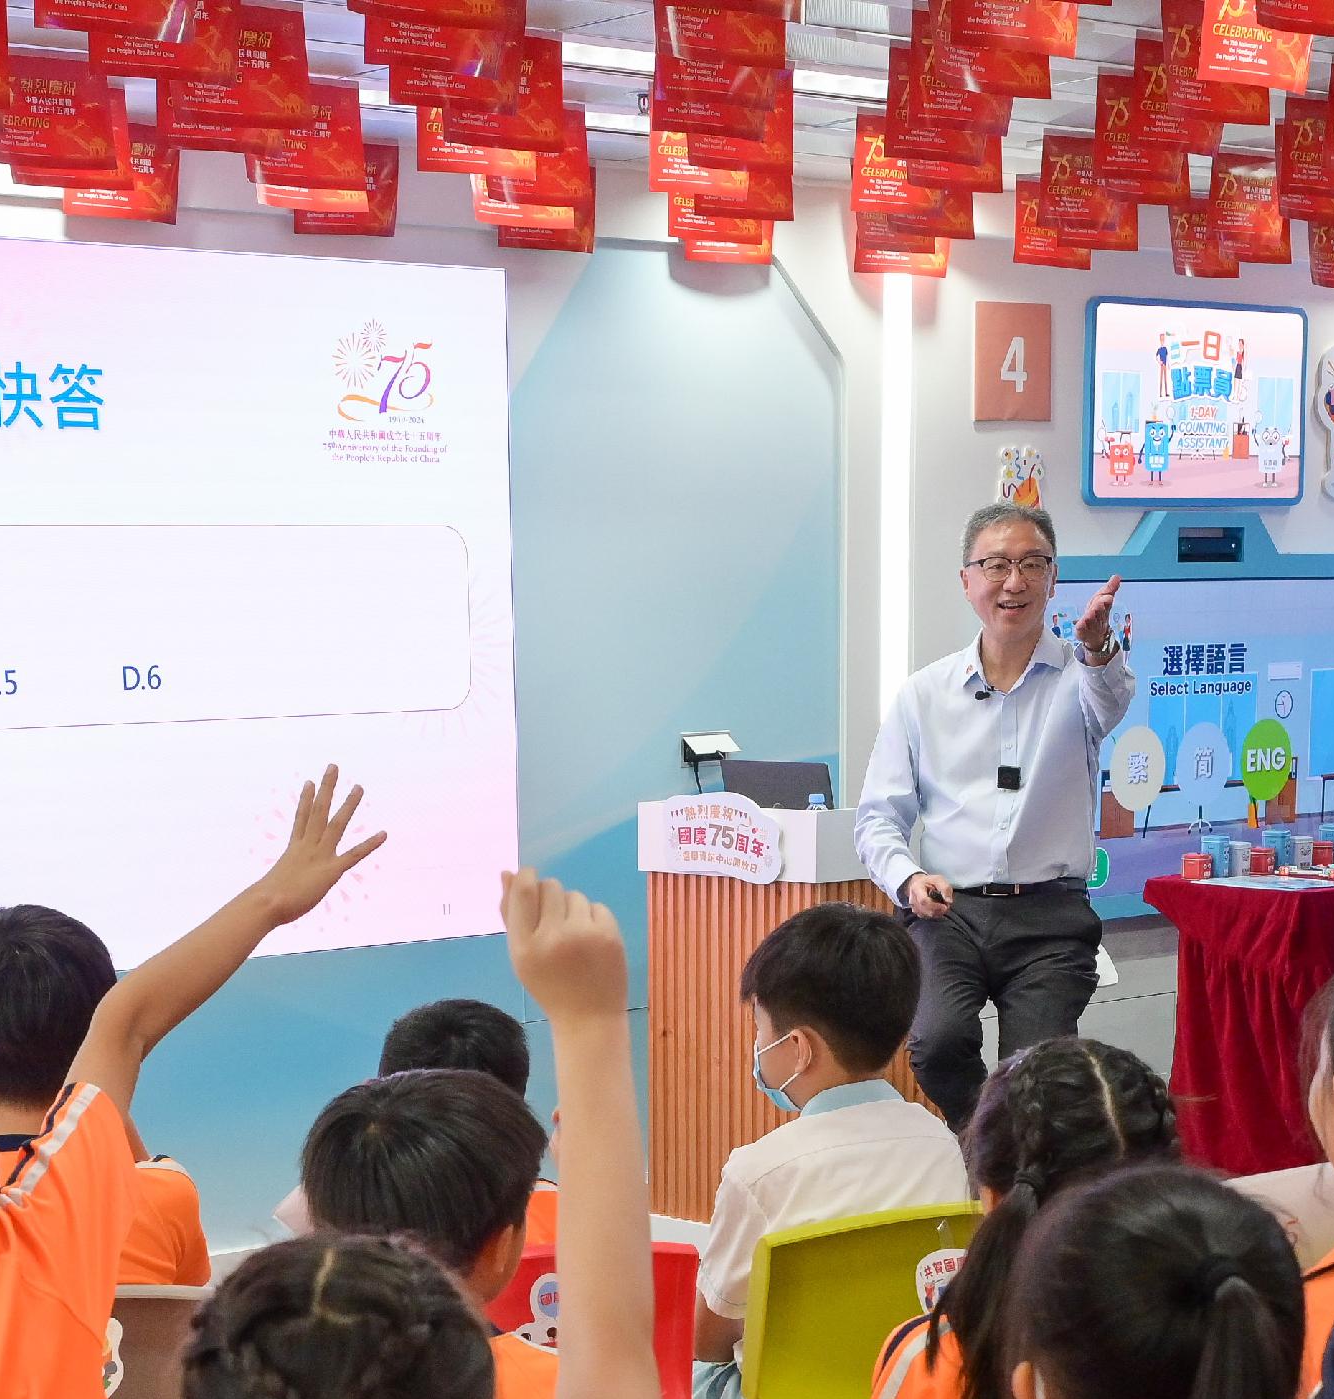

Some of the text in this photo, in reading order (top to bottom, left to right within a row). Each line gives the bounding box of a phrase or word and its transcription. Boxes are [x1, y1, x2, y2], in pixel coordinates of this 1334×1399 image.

[1213, 23, 1272, 42] CELEBRATING
[3, 115, 49, 128] EBRATING
[378, 343, 432, 413] 75
[1000, 336, 1028, 394] 4
[1178, 422, 1226, 433] COUNTING
[1177, 438, 1228, 449] ASSISTANT
[1163, 643, 1247, 675] 選擇語言
[121, 664, 162, 691] D.6
[1150, 680, 1252, 698] Select Language
[1127, 752, 1148, 784] 繁
[1246, 747, 1286, 773] ENG
[684, 804, 733, 821] 熱烈慶祝
[678, 824, 764, 857] 國慶75周年
